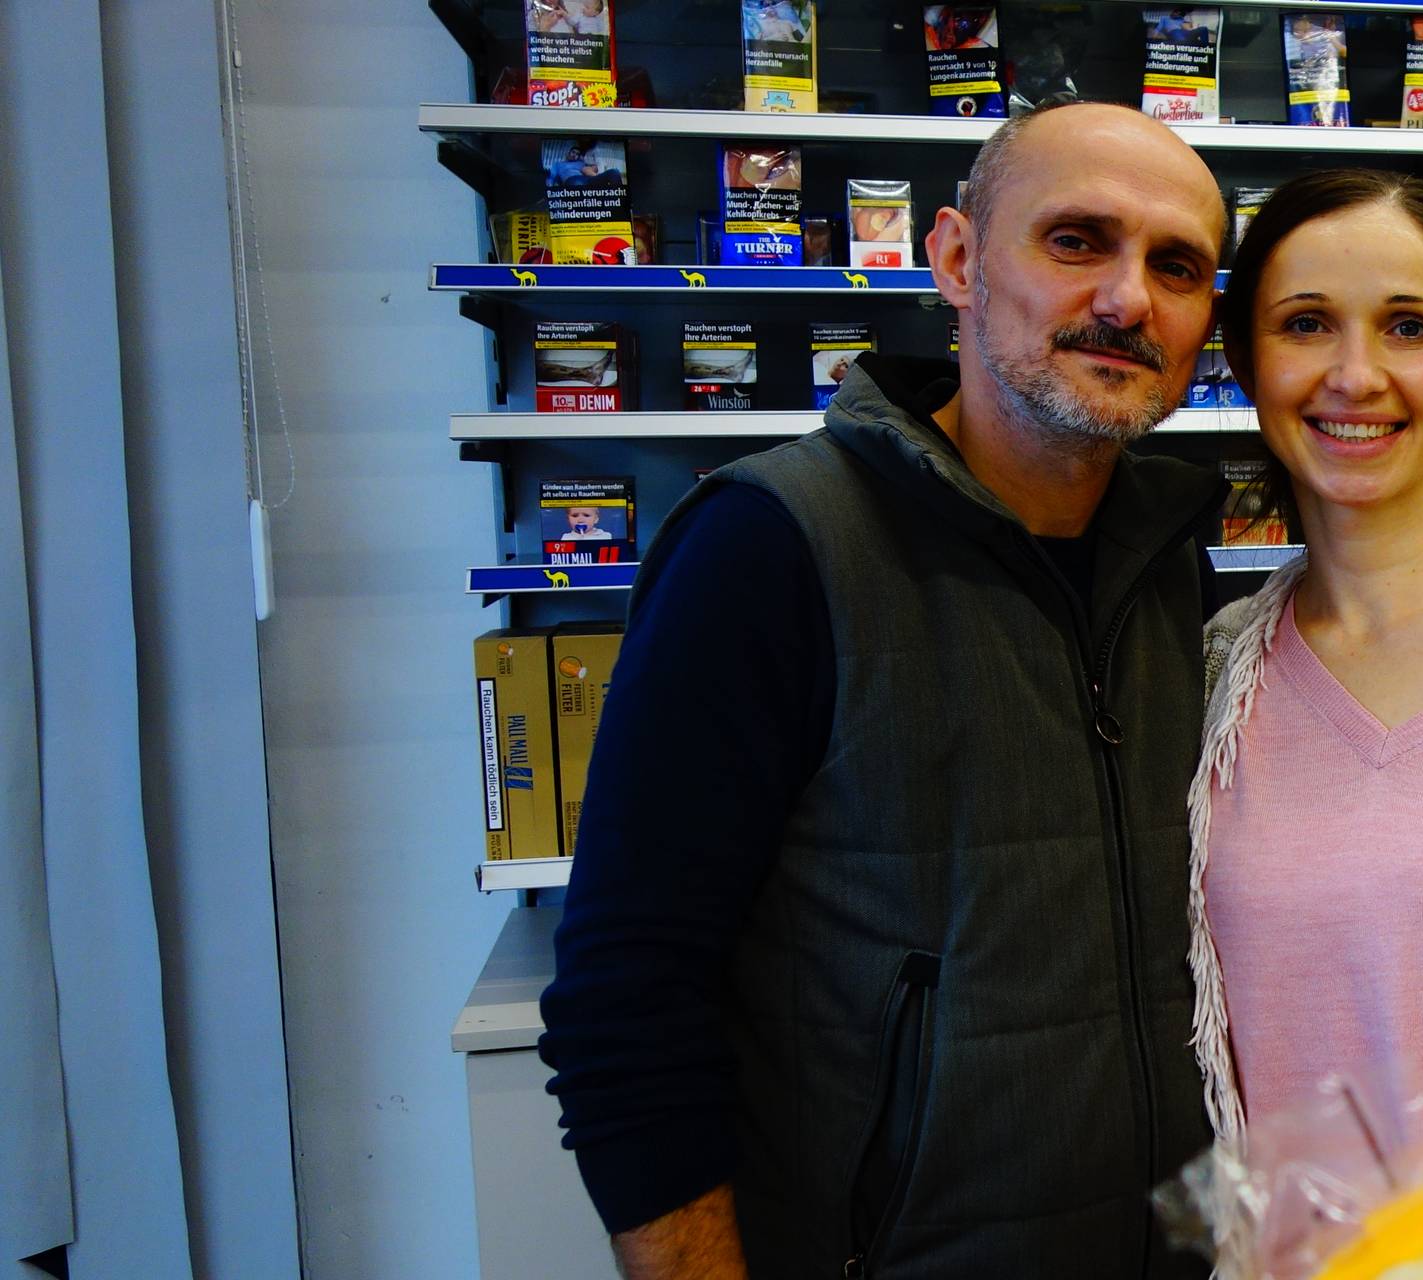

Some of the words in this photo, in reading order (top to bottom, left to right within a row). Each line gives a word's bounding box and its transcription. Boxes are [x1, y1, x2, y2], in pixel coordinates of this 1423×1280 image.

[530, 36, 554, 45] Kinder
[555, 38, 569, 46] von
[570, 38, 603, 47] Rauchern
[571, 48, 592, 56] selbst
[1147, 43, 1175, 51] auchen
[1176, 44, 1214, 54] verursacht
[541, 55, 574, 63] Rauchern
[745, 50, 773, 58] Rauchen
[774, 52, 809, 60] verursacht
[928, 53, 957, 62] Rauchen
[1194, 55, 1208, 63] und
[745, 58, 783, 67] Herzanfälle
[929, 61, 964, 71] verursacht
[966, 61, 971, 69] 9
[930, 70, 996, 81] Lungenkarzinomen
[547, 188, 580, 197] Rauchen
[582, 188, 626, 197] verursacht
[726, 191, 758, 199] Rauchen
[759, 193, 797, 201] verursacht
[548, 198, 602, 209] Schlaganfälle
[605, 199, 621, 207] und
[550, 209, 612, 219] Behinderungen
[726, 210, 780, 220] Kehlkopfkrebs
[734, 243, 793, 255] TURNER
[537, 324, 564, 332] Rauchen
[565, 324, 594, 333] verstopft
[685, 324, 717, 332] Rauchen
[718, 324, 752, 333] verstopft
[551, 332, 577, 340] Arterien
[701, 333, 732, 341] Arterien
[579, 394, 615, 410] DENIM
[707, 393, 750, 409] Winston
[561, 684, 574, 713] FILTER
[483, 689, 492, 734] Rauchen
[485, 736, 494, 762] kann
[488, 764, 497, 799] tödlich
[490, 801, 498, 821] sein
